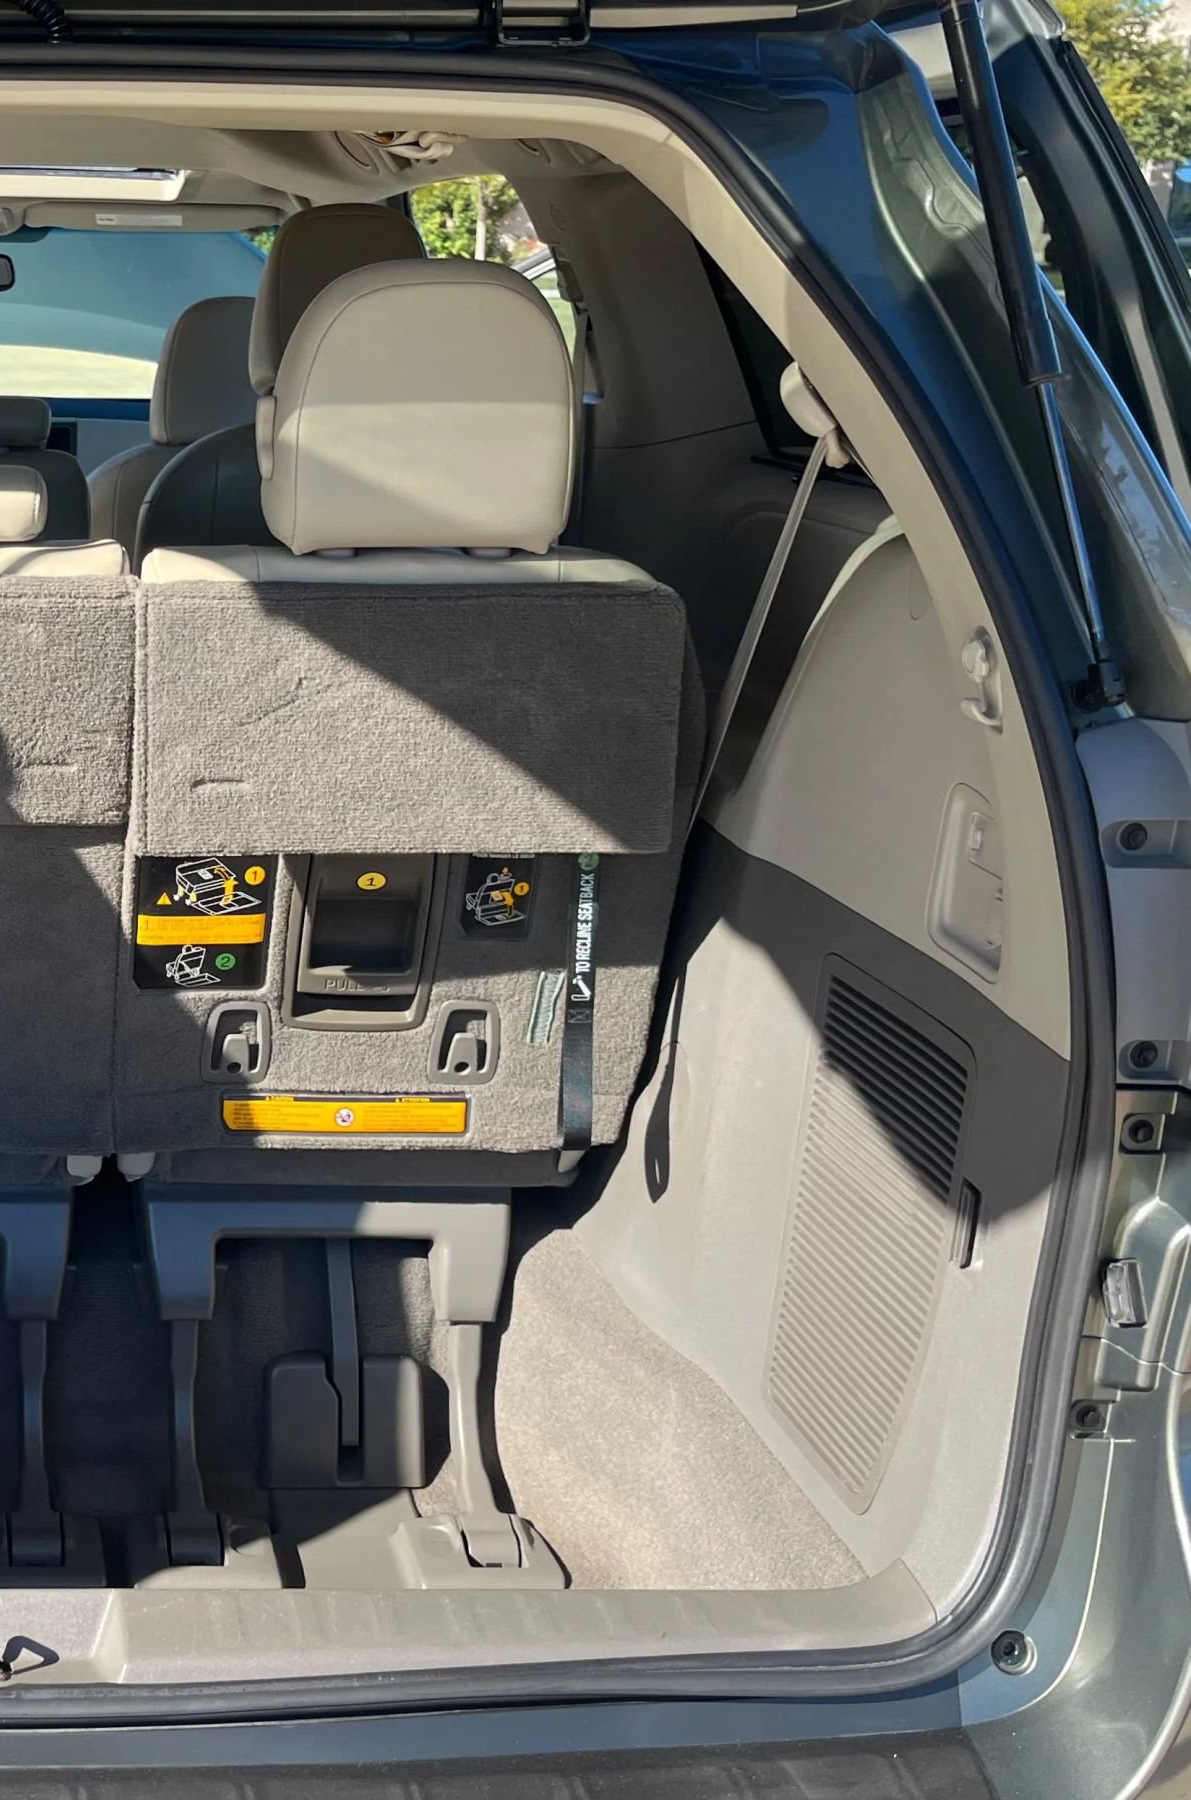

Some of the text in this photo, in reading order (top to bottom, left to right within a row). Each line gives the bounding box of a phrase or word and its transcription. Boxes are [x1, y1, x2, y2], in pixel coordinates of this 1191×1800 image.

[575, 873, 594, 973] TO RECLINE SEATBACK
